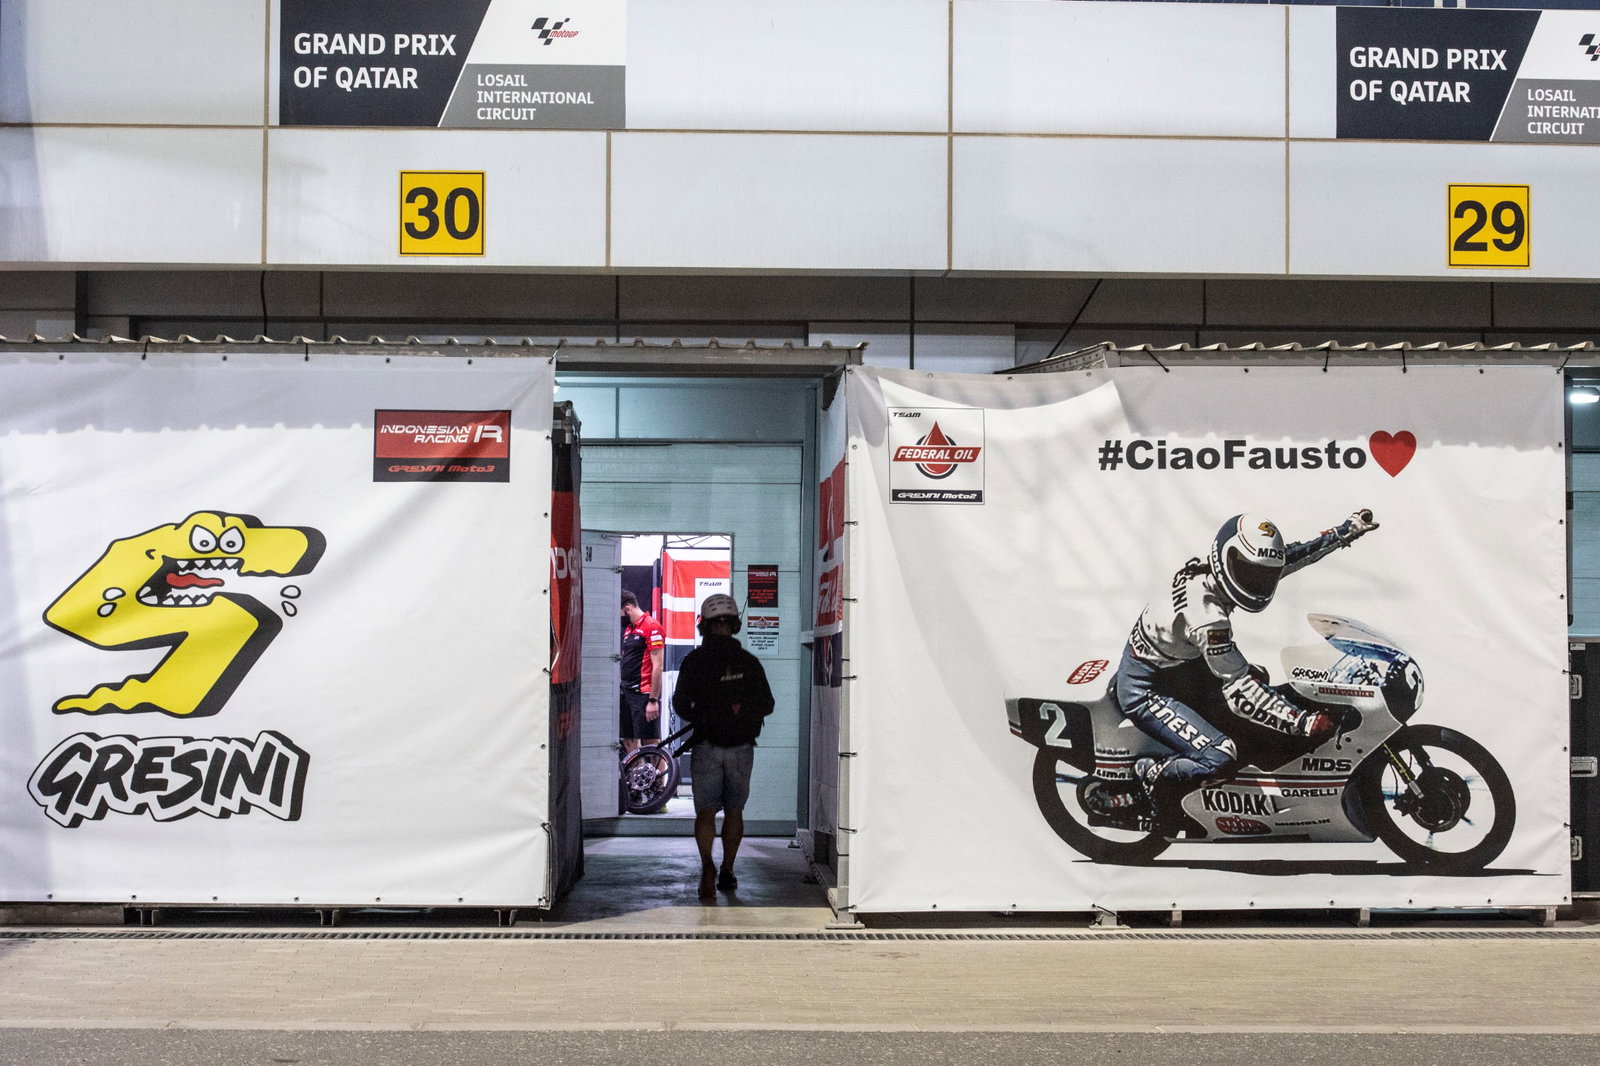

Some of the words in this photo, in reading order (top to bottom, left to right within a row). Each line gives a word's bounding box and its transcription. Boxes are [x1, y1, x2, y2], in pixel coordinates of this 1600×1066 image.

[293, 33, 386, 56] GRAND
[394, 34, 457, 56] PRIX
[1350, 46, 1439, 70] GRAND
[1446, 48, 1508, 71] PRIX
[293, 66, 328, 88] OF
[335, 67, 419, 92] QATAR
[476, 74, 528, 87] LOSAIL
[476, 90, 595, 105] INTERNATIONAL
[1350, 79, 1383, 101] OF
[1390, 80, 1471, 105] QATAR
[1527, 88, 1577, 102] LOSAIL
[476, 107, 537, 121] CIRCUIT
[1527, 121, 1585, 135] CIRCUIT
[404, 186, 480, 241] 30
[1453, 200, 1525, 252] 29
[380, 424, 472, 434] INDONESIAN
[414, 434, 469, 444] RACING
[897, 448, 951, 460] FEDERAL
[953, 449, 974, 460] OIL
[1098, 439, 1367, 471] #CiaoFausto
[1257, 547, 1284, 561] MDS
[1229, 687, 1296, 736] KODAK
[1039, 702, 1073, 749] 2
[1301, 758, 1352, 771] MDS
[34, 738, 298, 818] GRESINI
[1201, 789, 1271, 816] KODAK
[1281, 788, 1338, 798] GARELLI
